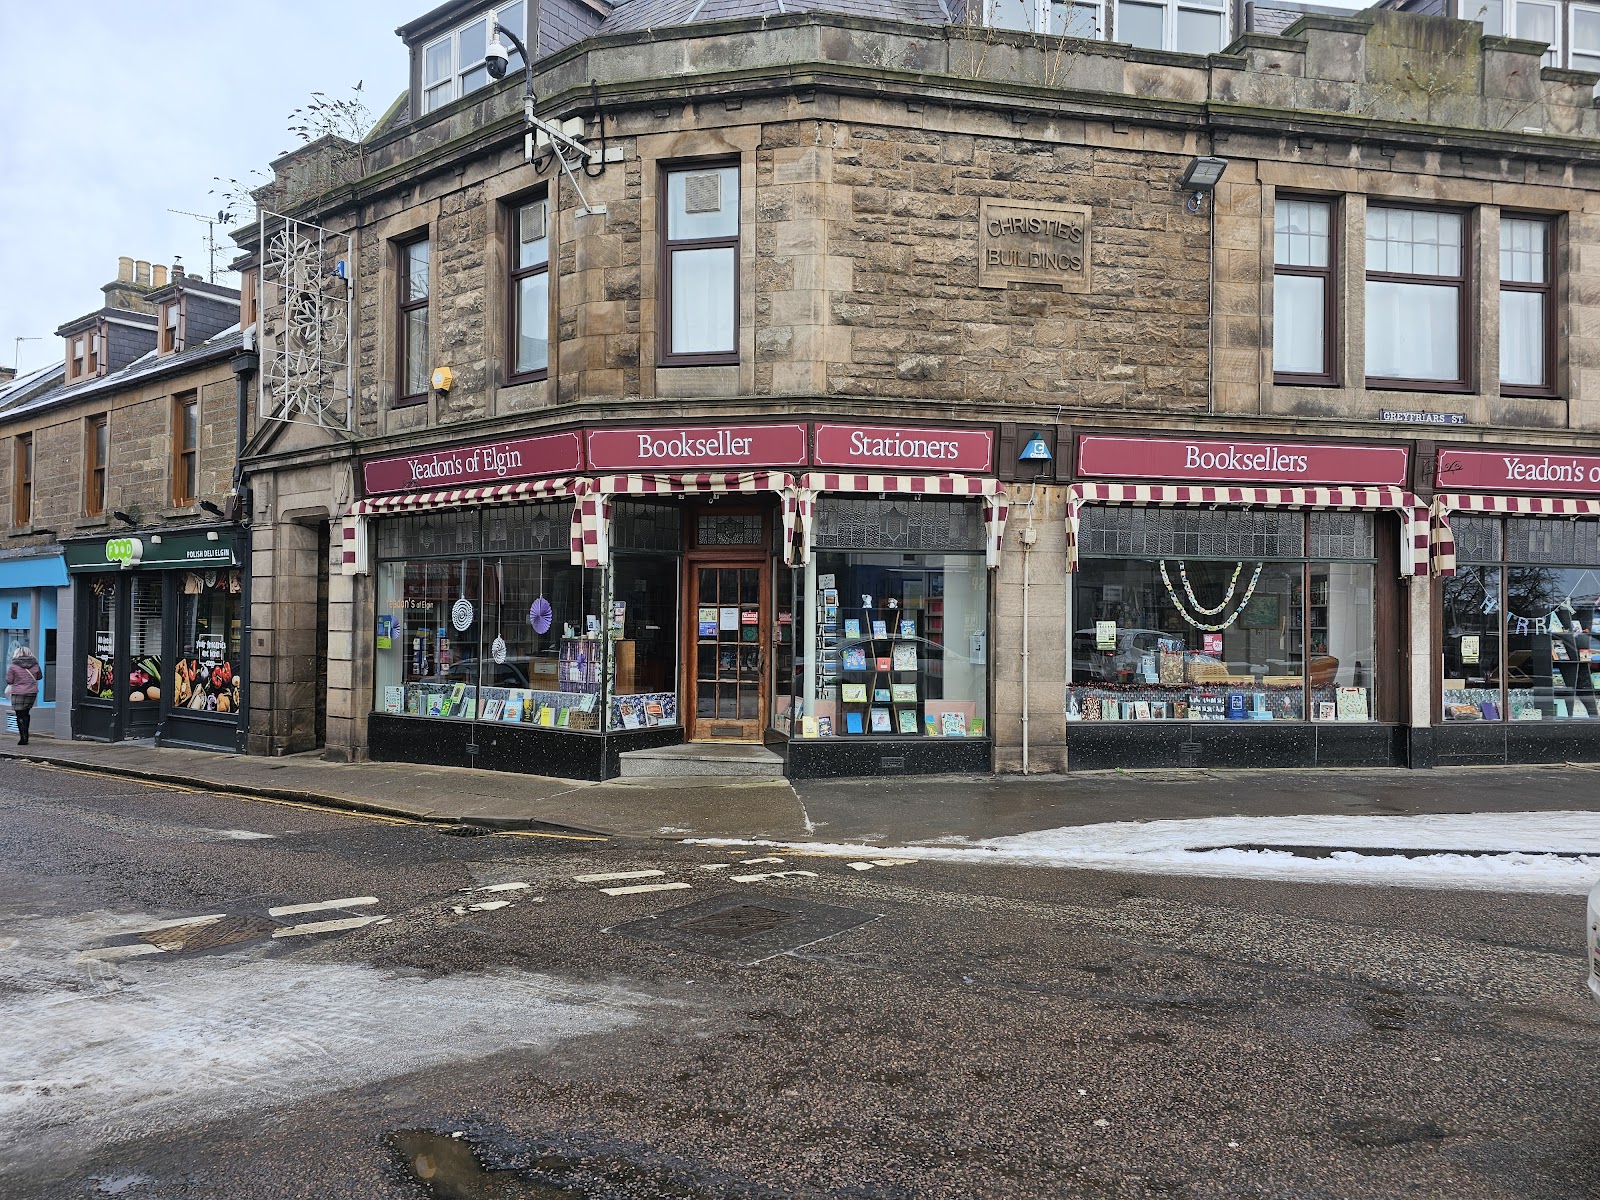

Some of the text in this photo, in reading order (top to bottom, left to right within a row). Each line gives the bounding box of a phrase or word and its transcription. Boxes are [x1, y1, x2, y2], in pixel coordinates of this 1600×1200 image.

[986, 216, 1082, 243] CHRISTIE'S
[987, 248, 1081, 271] BUILDINGS
[1383, 411, 1464, 424] GREYFRIARS ST.
[637, 430, 752, 459] Bookseller
[849, 431, 959, 459] Stationers
[408, 446, 522, 480] Yeadon's of Elgin
[1184, 445, 1308, 472] Booksellers
[1503, 458, 1584, 482] Yeadon's
[186, 549, 230, 559] POLISH DELI ELGIN
[1480, 595, 1577, 636] HRRAY
